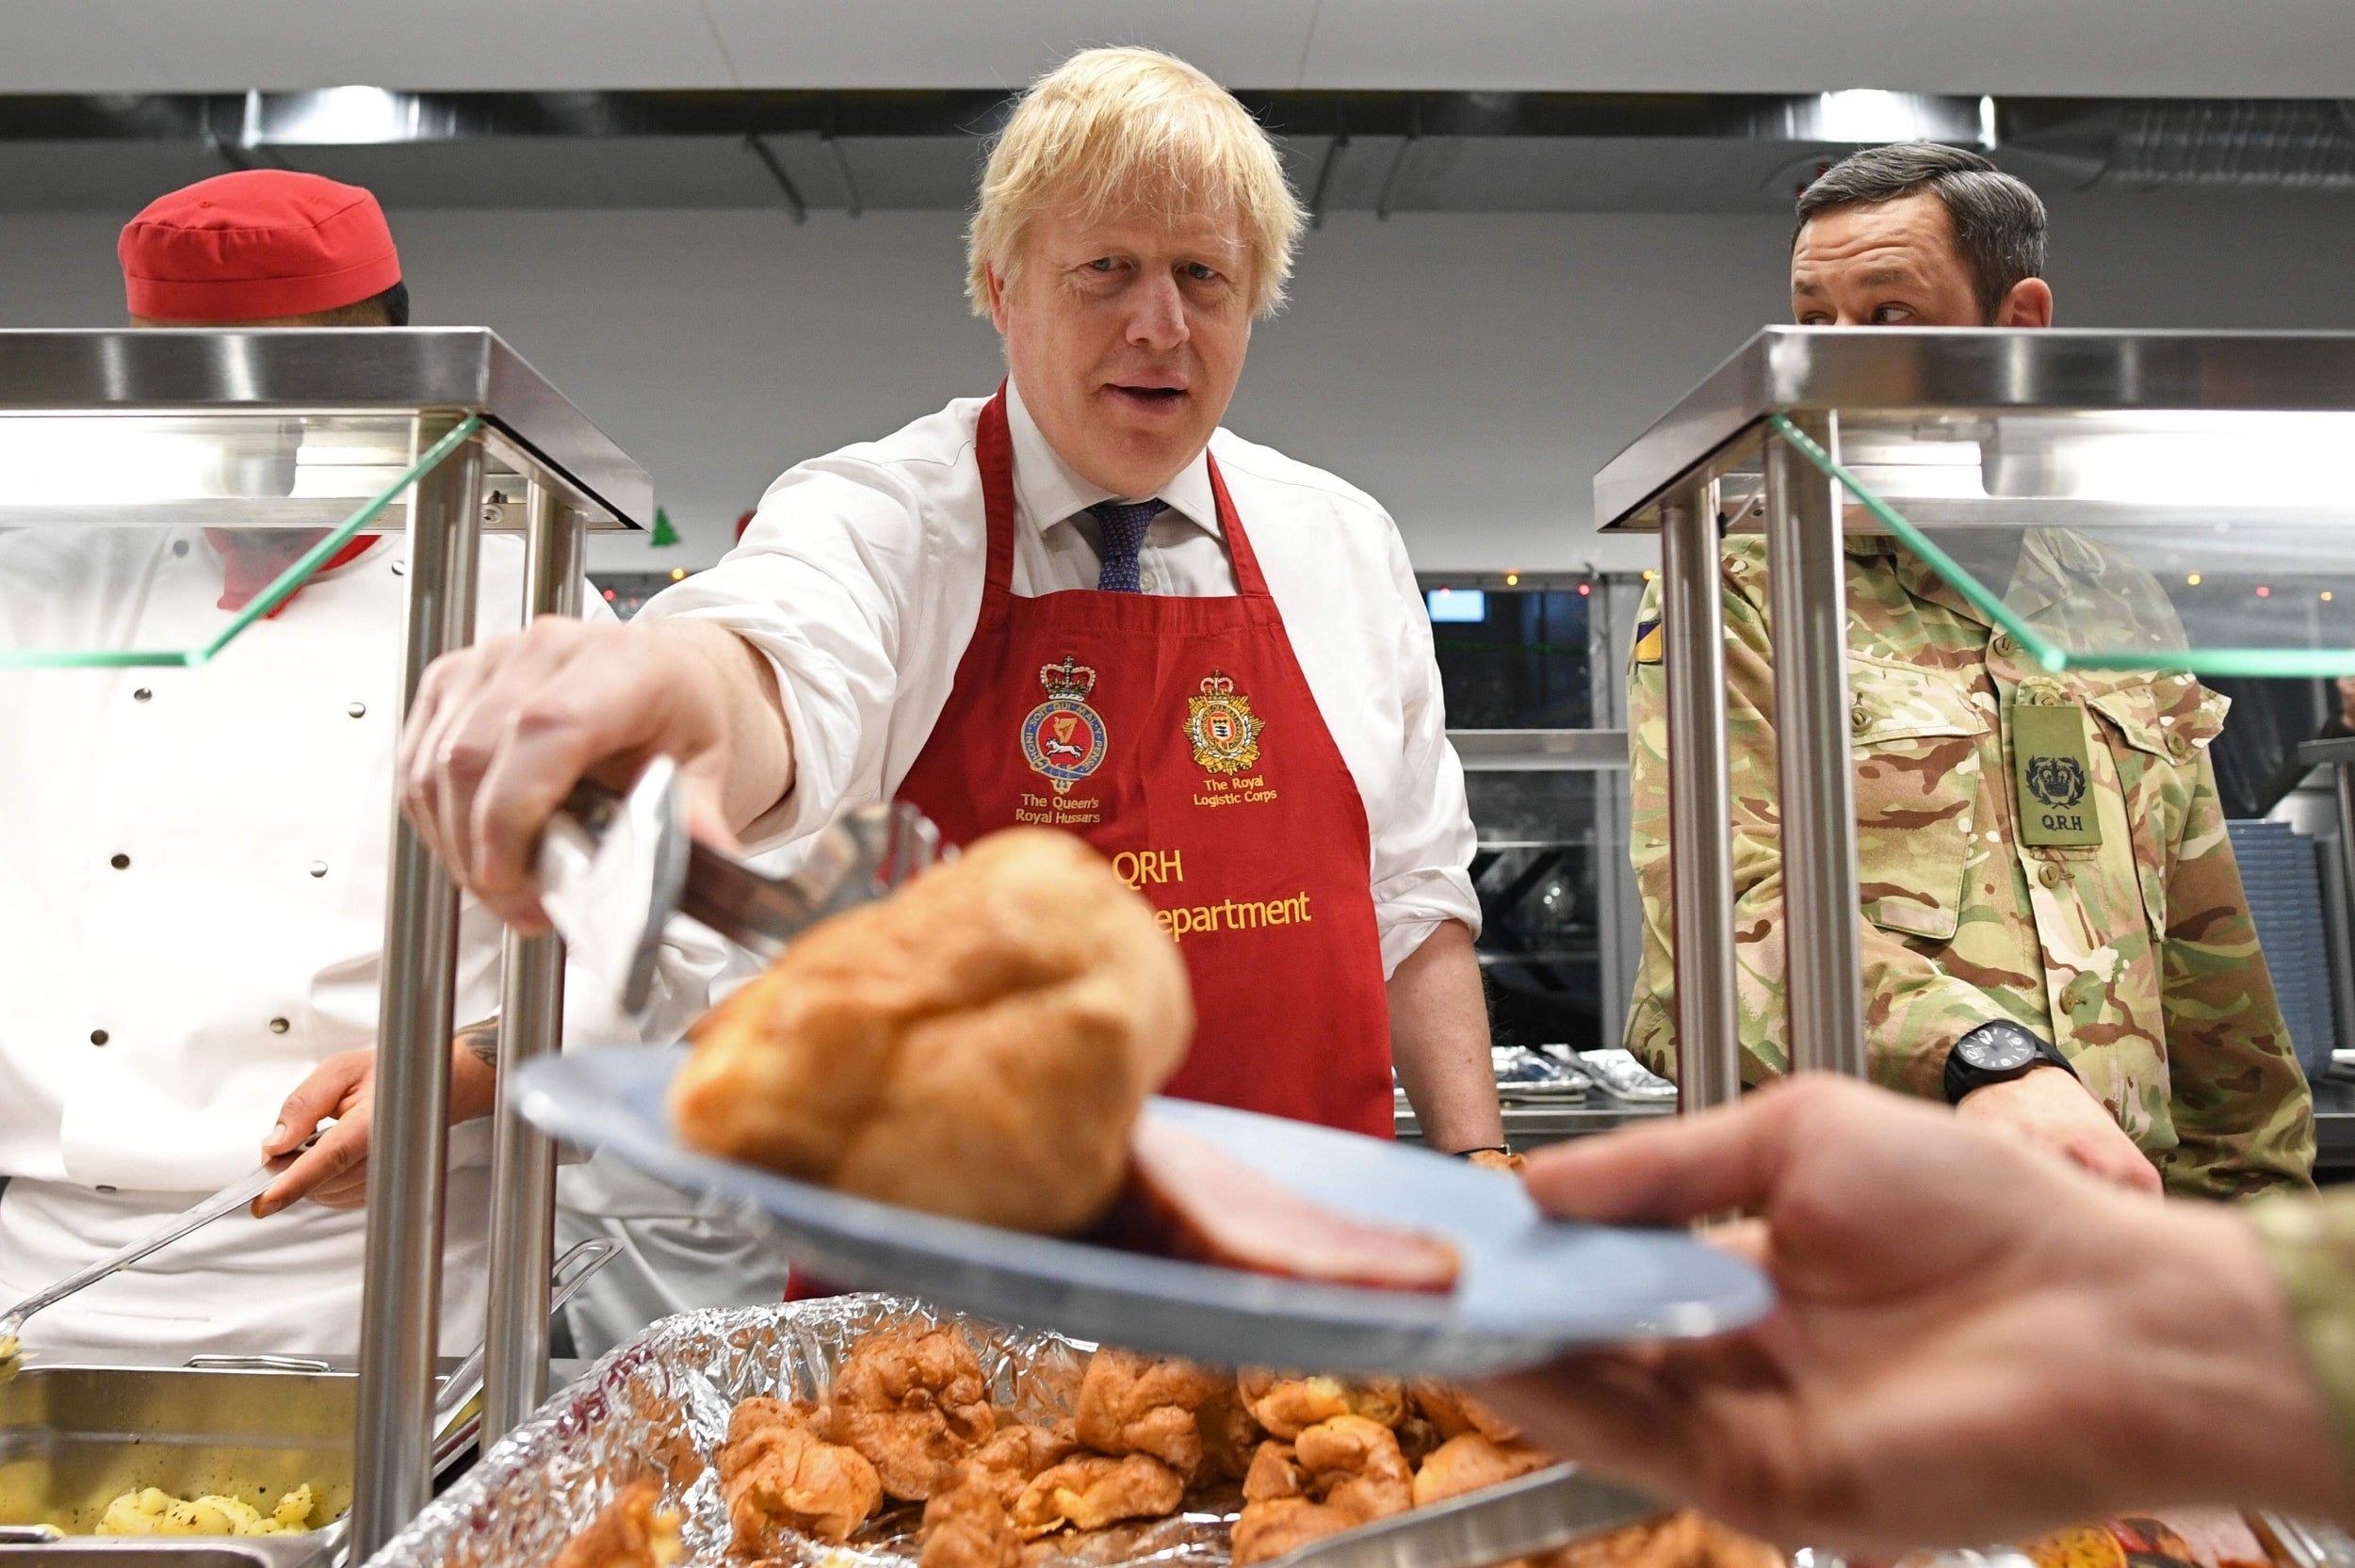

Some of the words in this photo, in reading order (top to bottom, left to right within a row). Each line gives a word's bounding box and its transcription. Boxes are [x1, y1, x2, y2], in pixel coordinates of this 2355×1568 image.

[1202, 778, 1228, 791] The
[1231, 774, 1264, 790] Royal
[1020, 793, 1048, 807] The
[1052, 796, 1099, 811] Queen's
[1193, 793, 1242, 808] Logistic
[1244, 789, 1278, 803] Corps
[1015, 808, 1053, 825] Royal
[1055, 811, 1101, 824] Hussars
[1112, 849, 1184, 891] QRH
[1150, 891, 1312, 943] epartment
